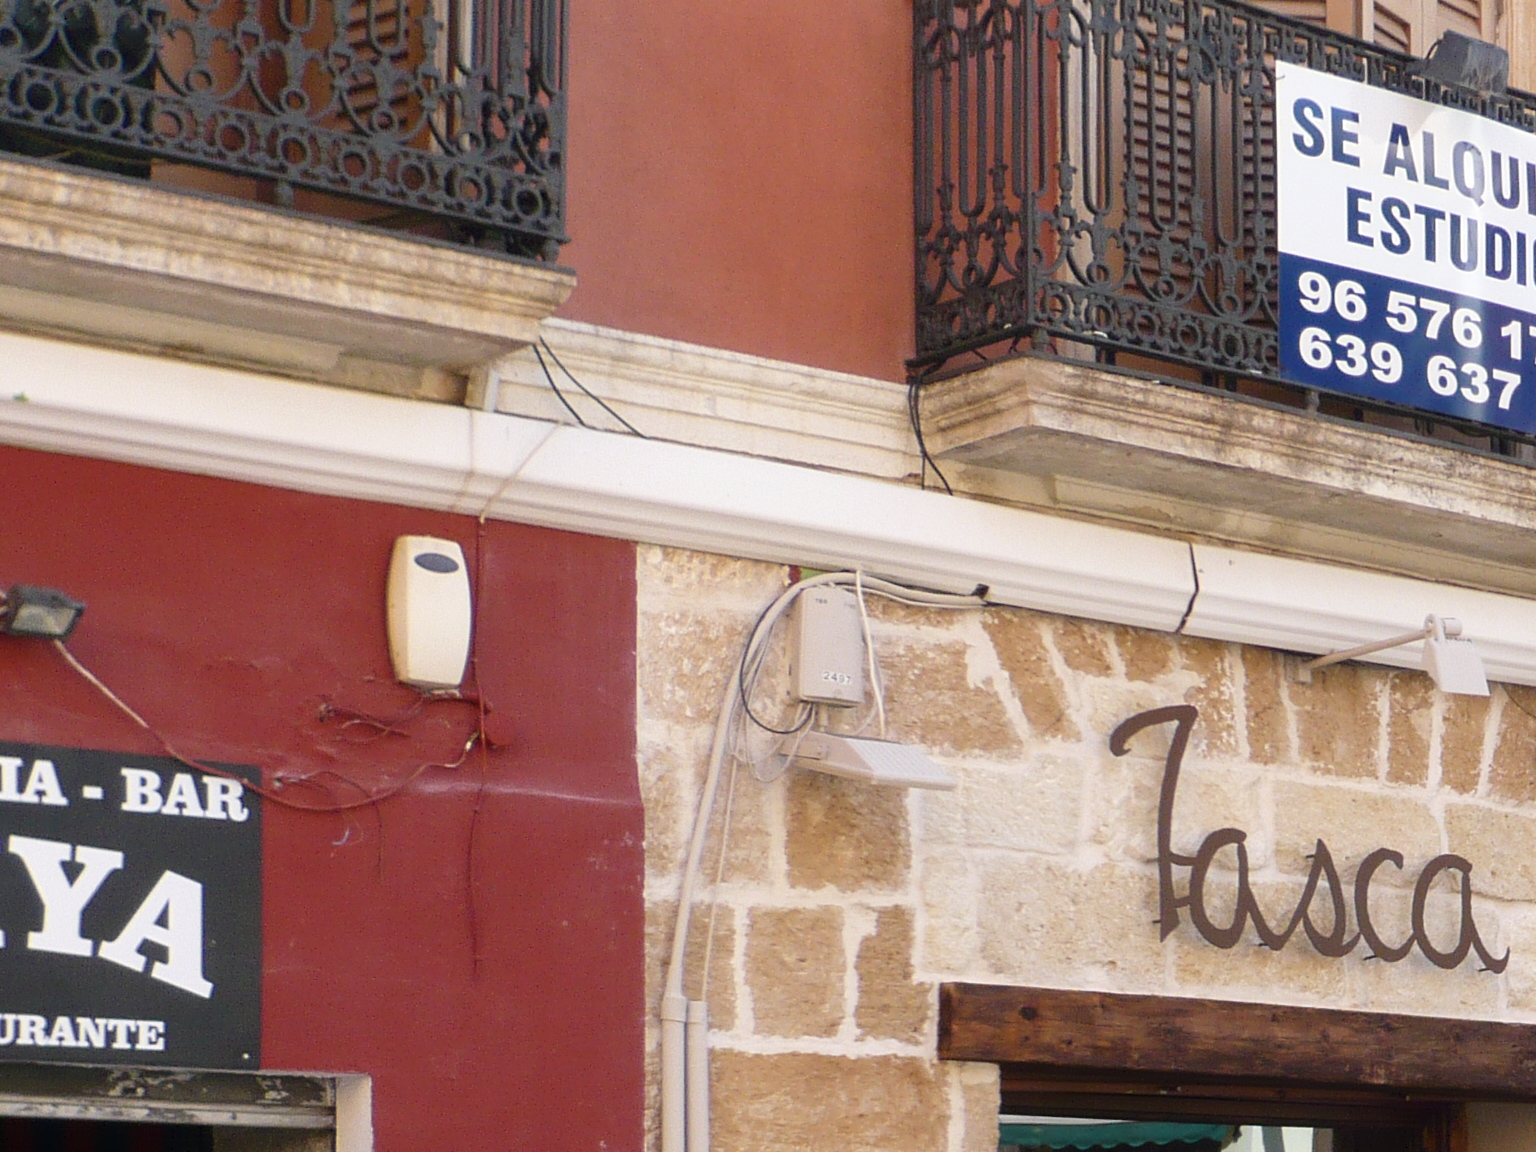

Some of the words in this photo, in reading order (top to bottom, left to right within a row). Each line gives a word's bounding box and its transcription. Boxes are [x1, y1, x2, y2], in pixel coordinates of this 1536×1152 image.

[1292, 98, 1361, 168] SE
[1298, 271, 1367, 322] 96
[1385, 291, 1483, 349] 576
[1299, 327, 1403, 384] 639
[1427, 355, 1521, 411] 637
[120, 767, 249, 823] BAR
[1109, 705, 1510, 974] Tasca
[0, 834, 215, 1000] YA
